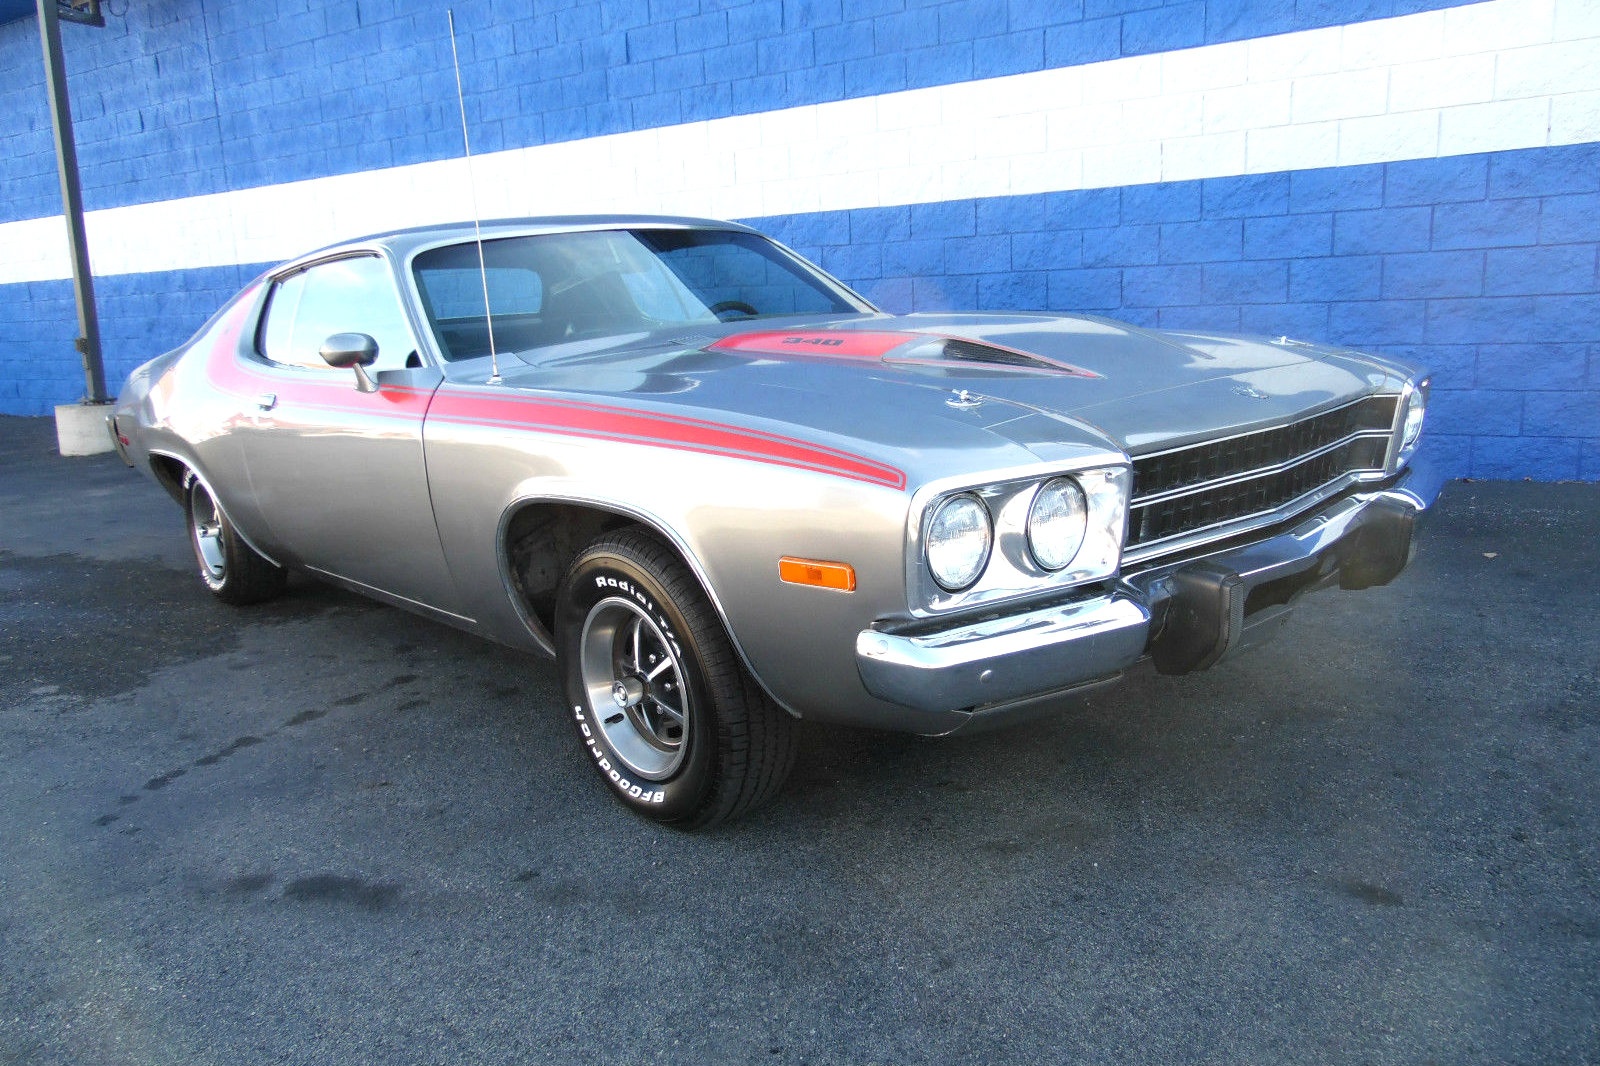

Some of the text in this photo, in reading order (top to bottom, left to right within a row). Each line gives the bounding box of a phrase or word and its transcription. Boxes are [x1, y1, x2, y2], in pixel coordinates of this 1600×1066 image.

[782, 337, 845, 346] 340
[595, 576, 653, 611] Radial
[574, 705, 665, 803] BFGoodrich
